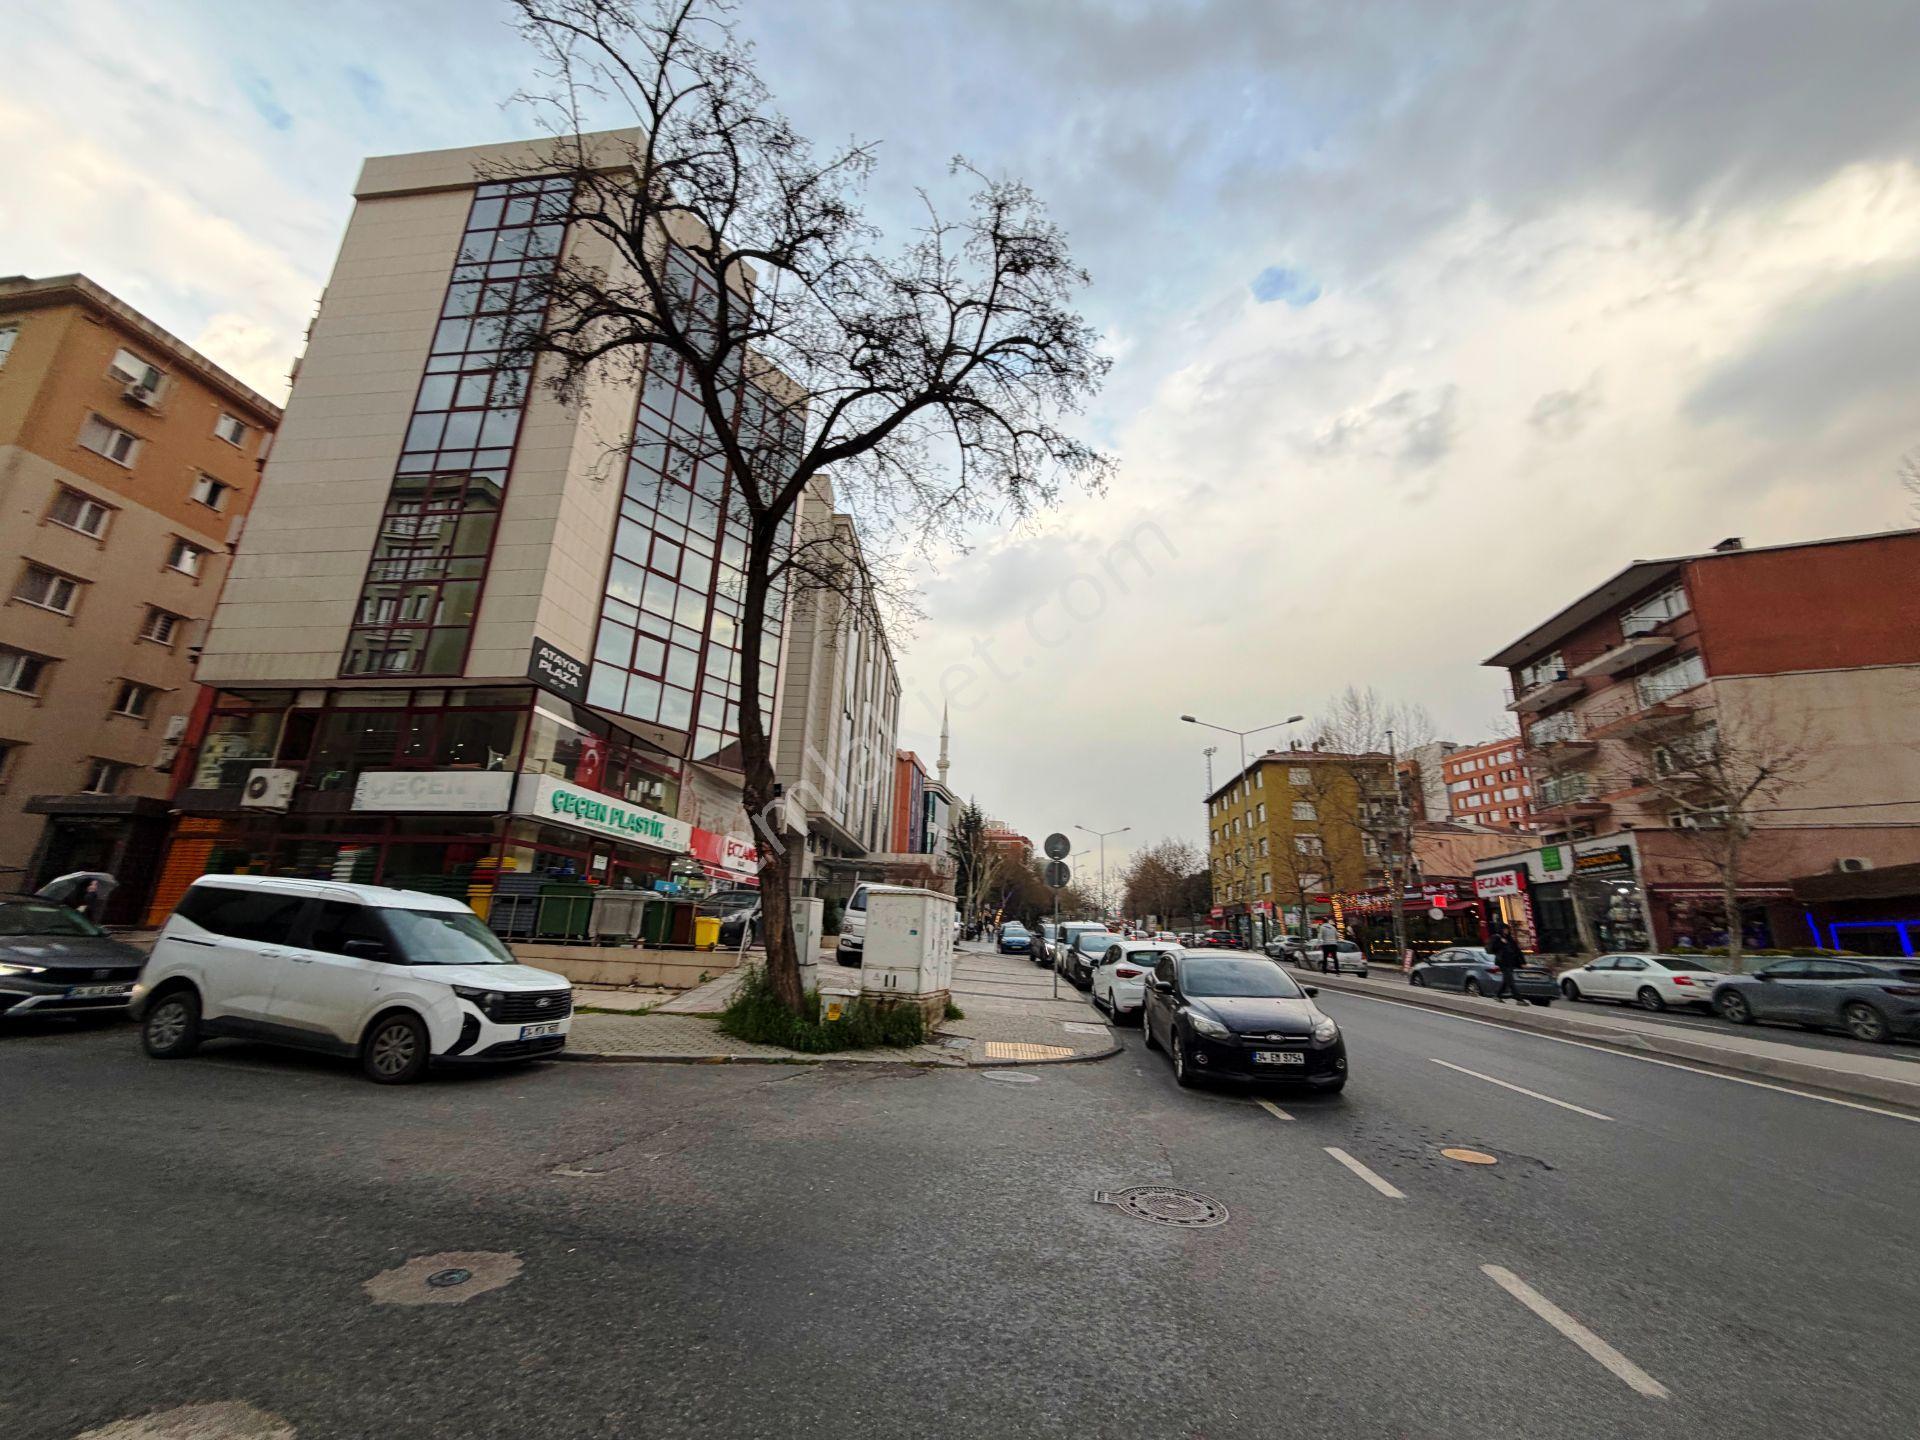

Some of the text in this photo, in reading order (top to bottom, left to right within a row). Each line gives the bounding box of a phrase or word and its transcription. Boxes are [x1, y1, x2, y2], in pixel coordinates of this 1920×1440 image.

[538, 647, 583, 677] ATAYOL
[538, 659, 579, 687] PLAZA
[552, 789, 607, 823] ÇEÇEN
[1478, 874, 1514, 889] ECZANE
